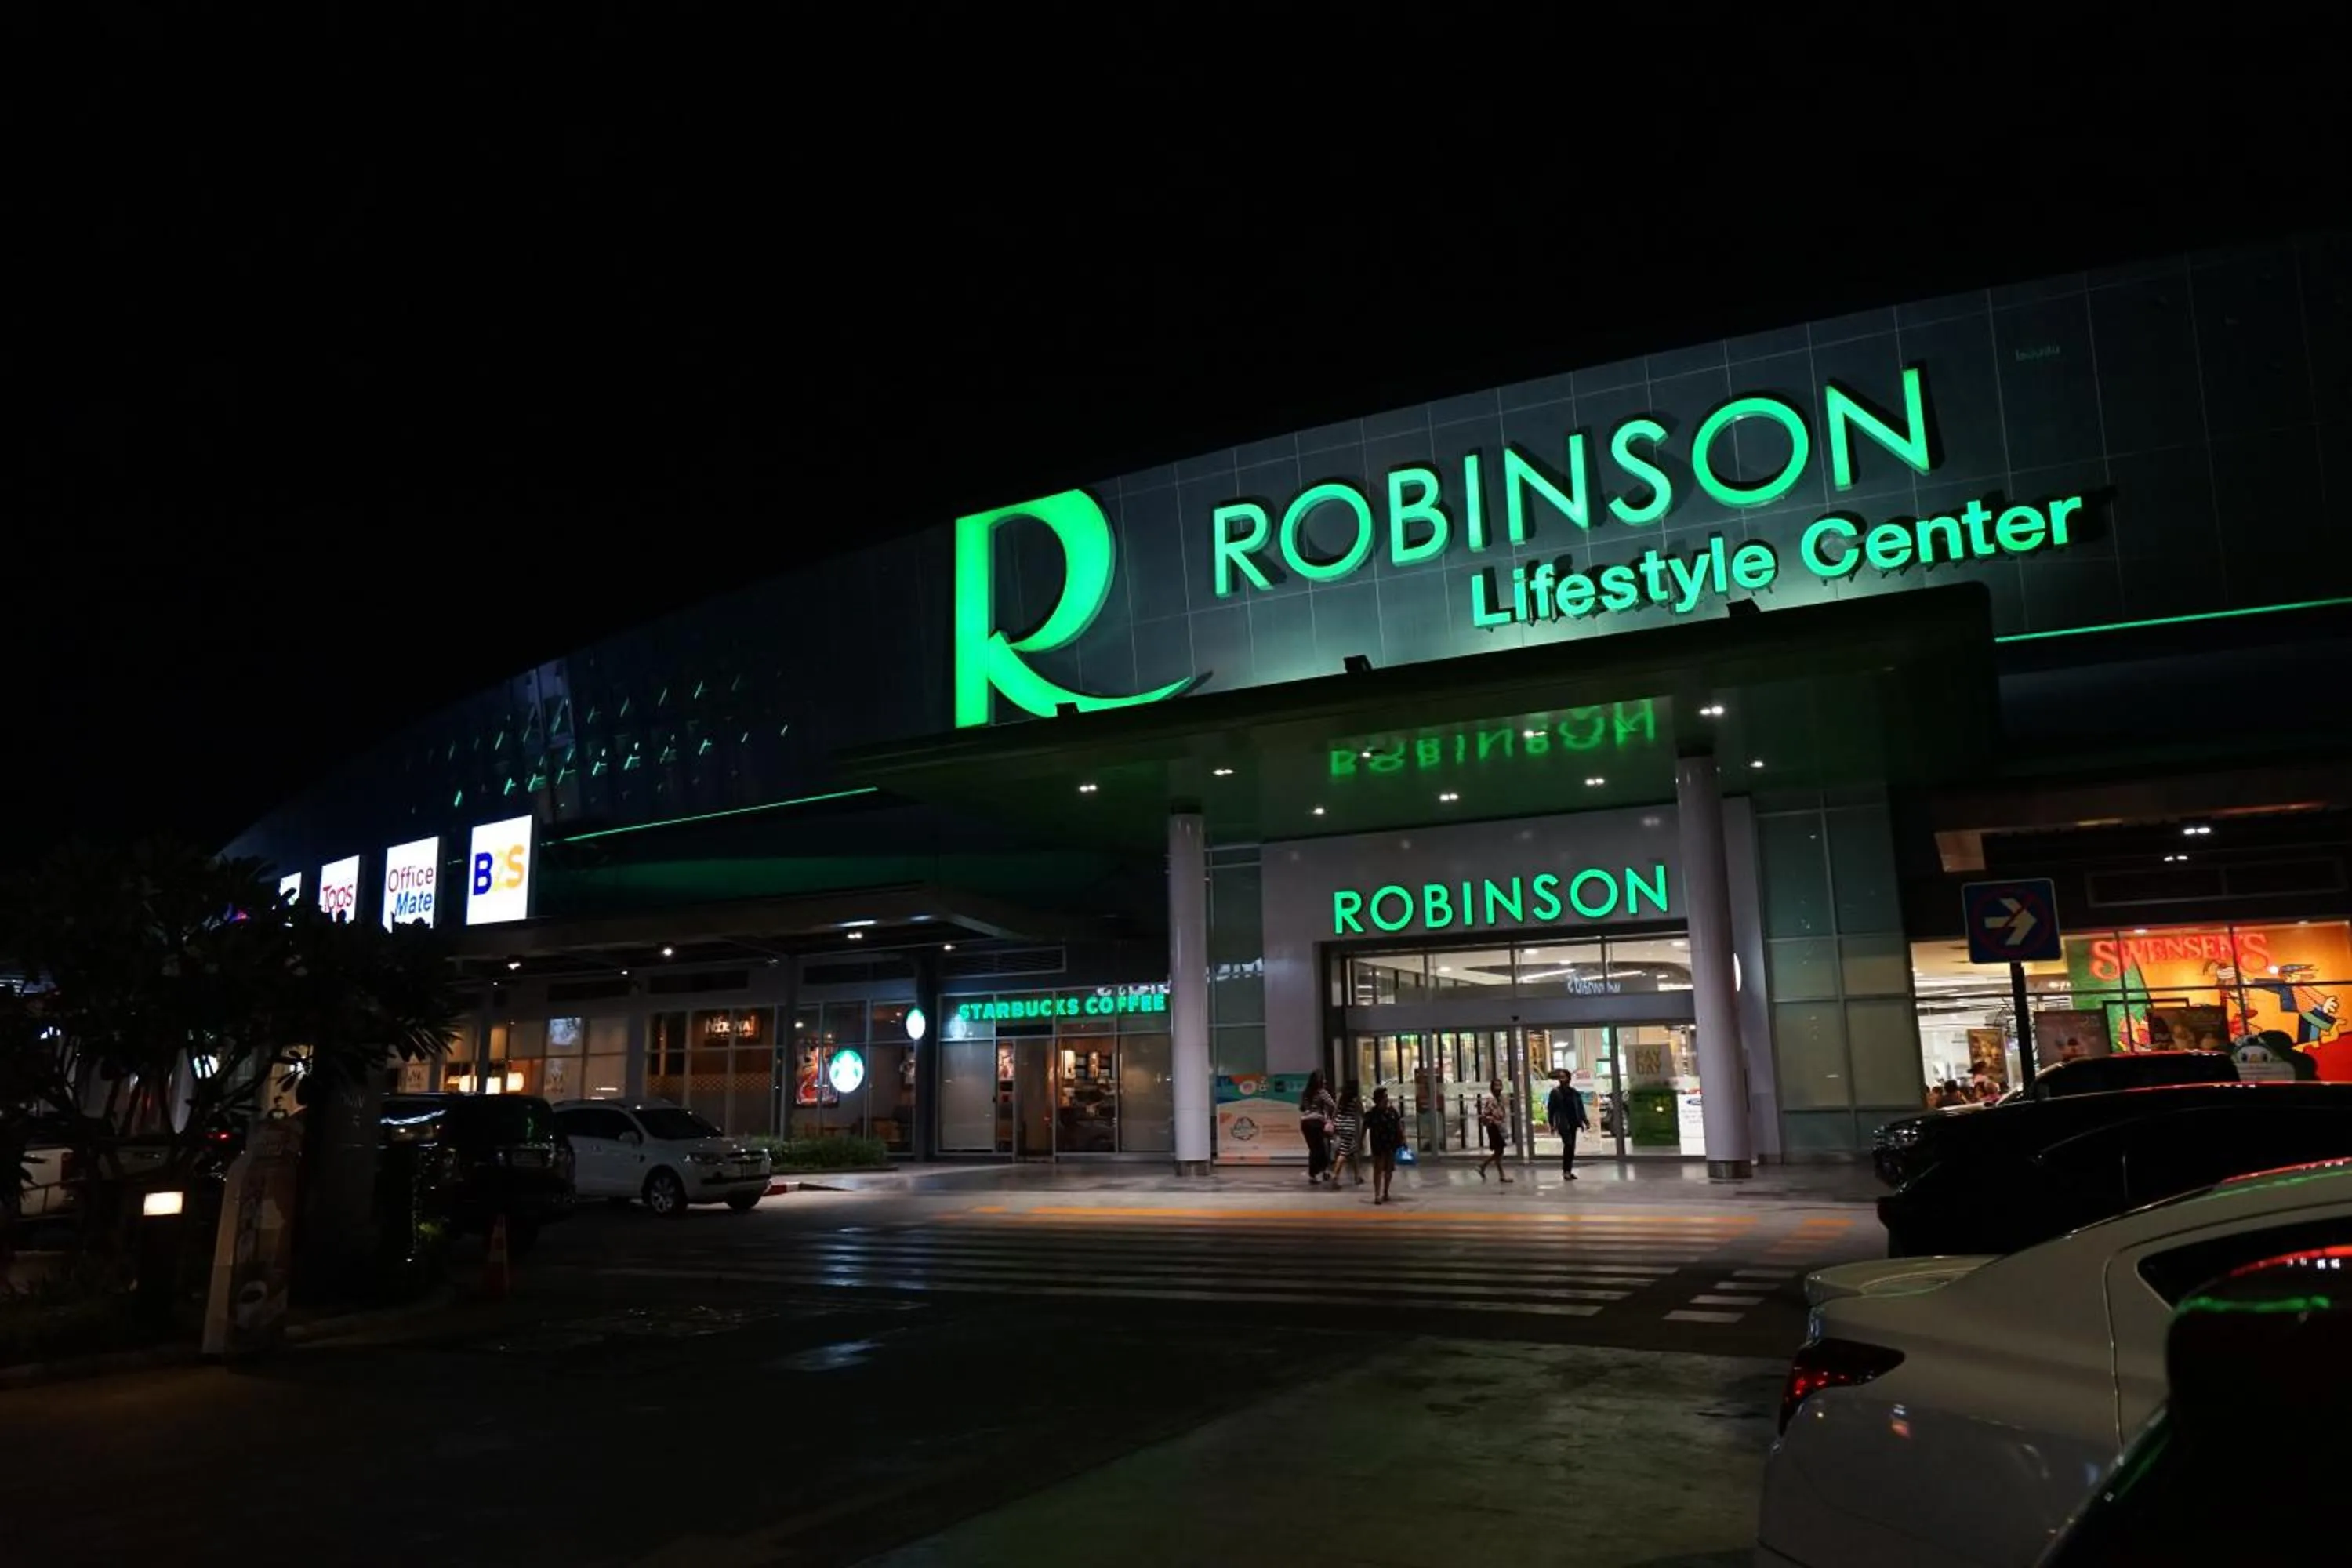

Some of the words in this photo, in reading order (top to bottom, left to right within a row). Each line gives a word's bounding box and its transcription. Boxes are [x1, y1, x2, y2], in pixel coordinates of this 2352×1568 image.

[1212, 367, 1931, 598] ROBINSON
[1471, 536, 1779, 629] Lifestyle
[1801, 495, 2082, 580] Center
[955, 488, 1193, 730] R
[388, 866, 434, 894] Office
[473, 844, 525, 896] B2S
[394, 890, 433, 916] Mate
[1334, 865, 1668, 935] ROBINSON
[2091, 933, 2271, 981] SWENSEN'S
[958, 997, 1080, 1020] STARBUCKS
[1085, 993, 1166, 1015] COFFEE
